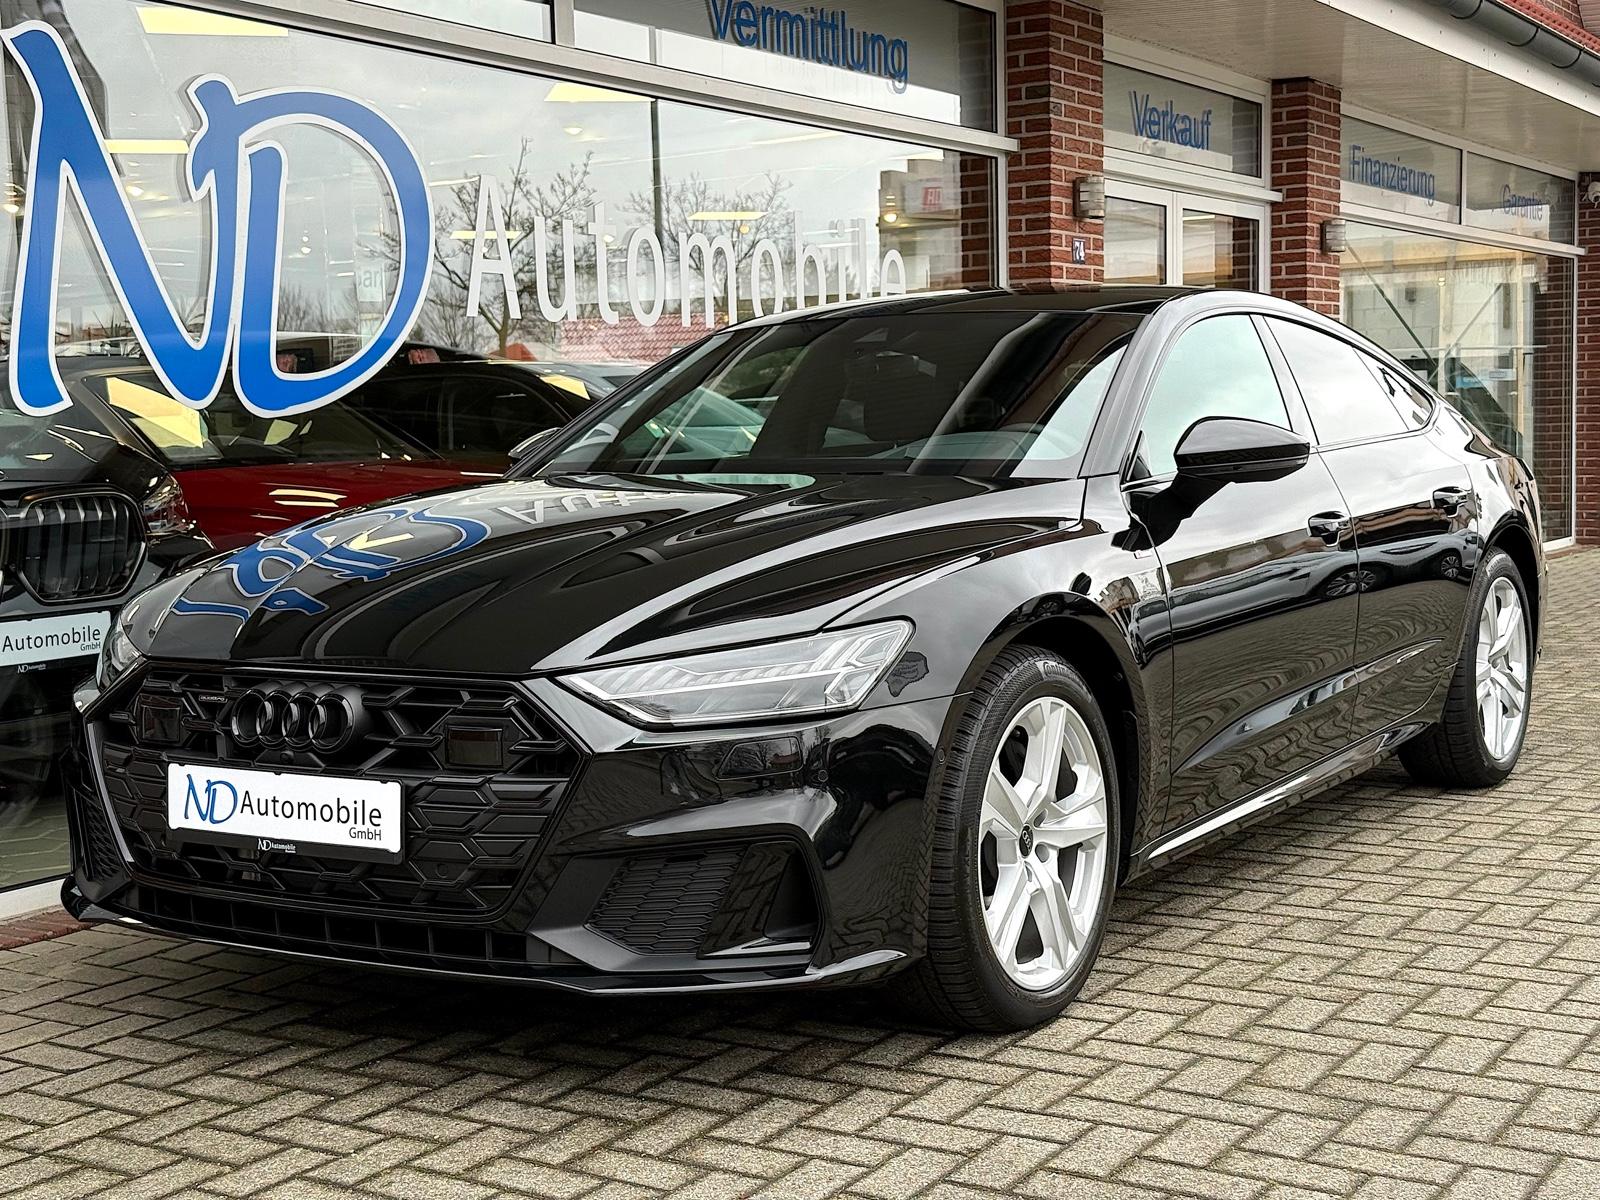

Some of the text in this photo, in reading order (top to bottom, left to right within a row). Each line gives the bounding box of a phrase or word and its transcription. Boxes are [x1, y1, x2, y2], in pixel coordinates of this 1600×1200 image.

[709, 0, 908, 95] Vermittlung
[1131, 90, 1212, 150] Verkauf
[1350, 144, 1435, 207] Finanzierung
[1502, 184, 1543, 221] Garantie
[0, 19, 907, 418] ND Automobile
[2, 625, 101, 652] Automobile
[80, 642, 101, 652] GmbH
[184, 773, 382, 827] ND Automobile
[348, 827, 382, 841] GmbH
